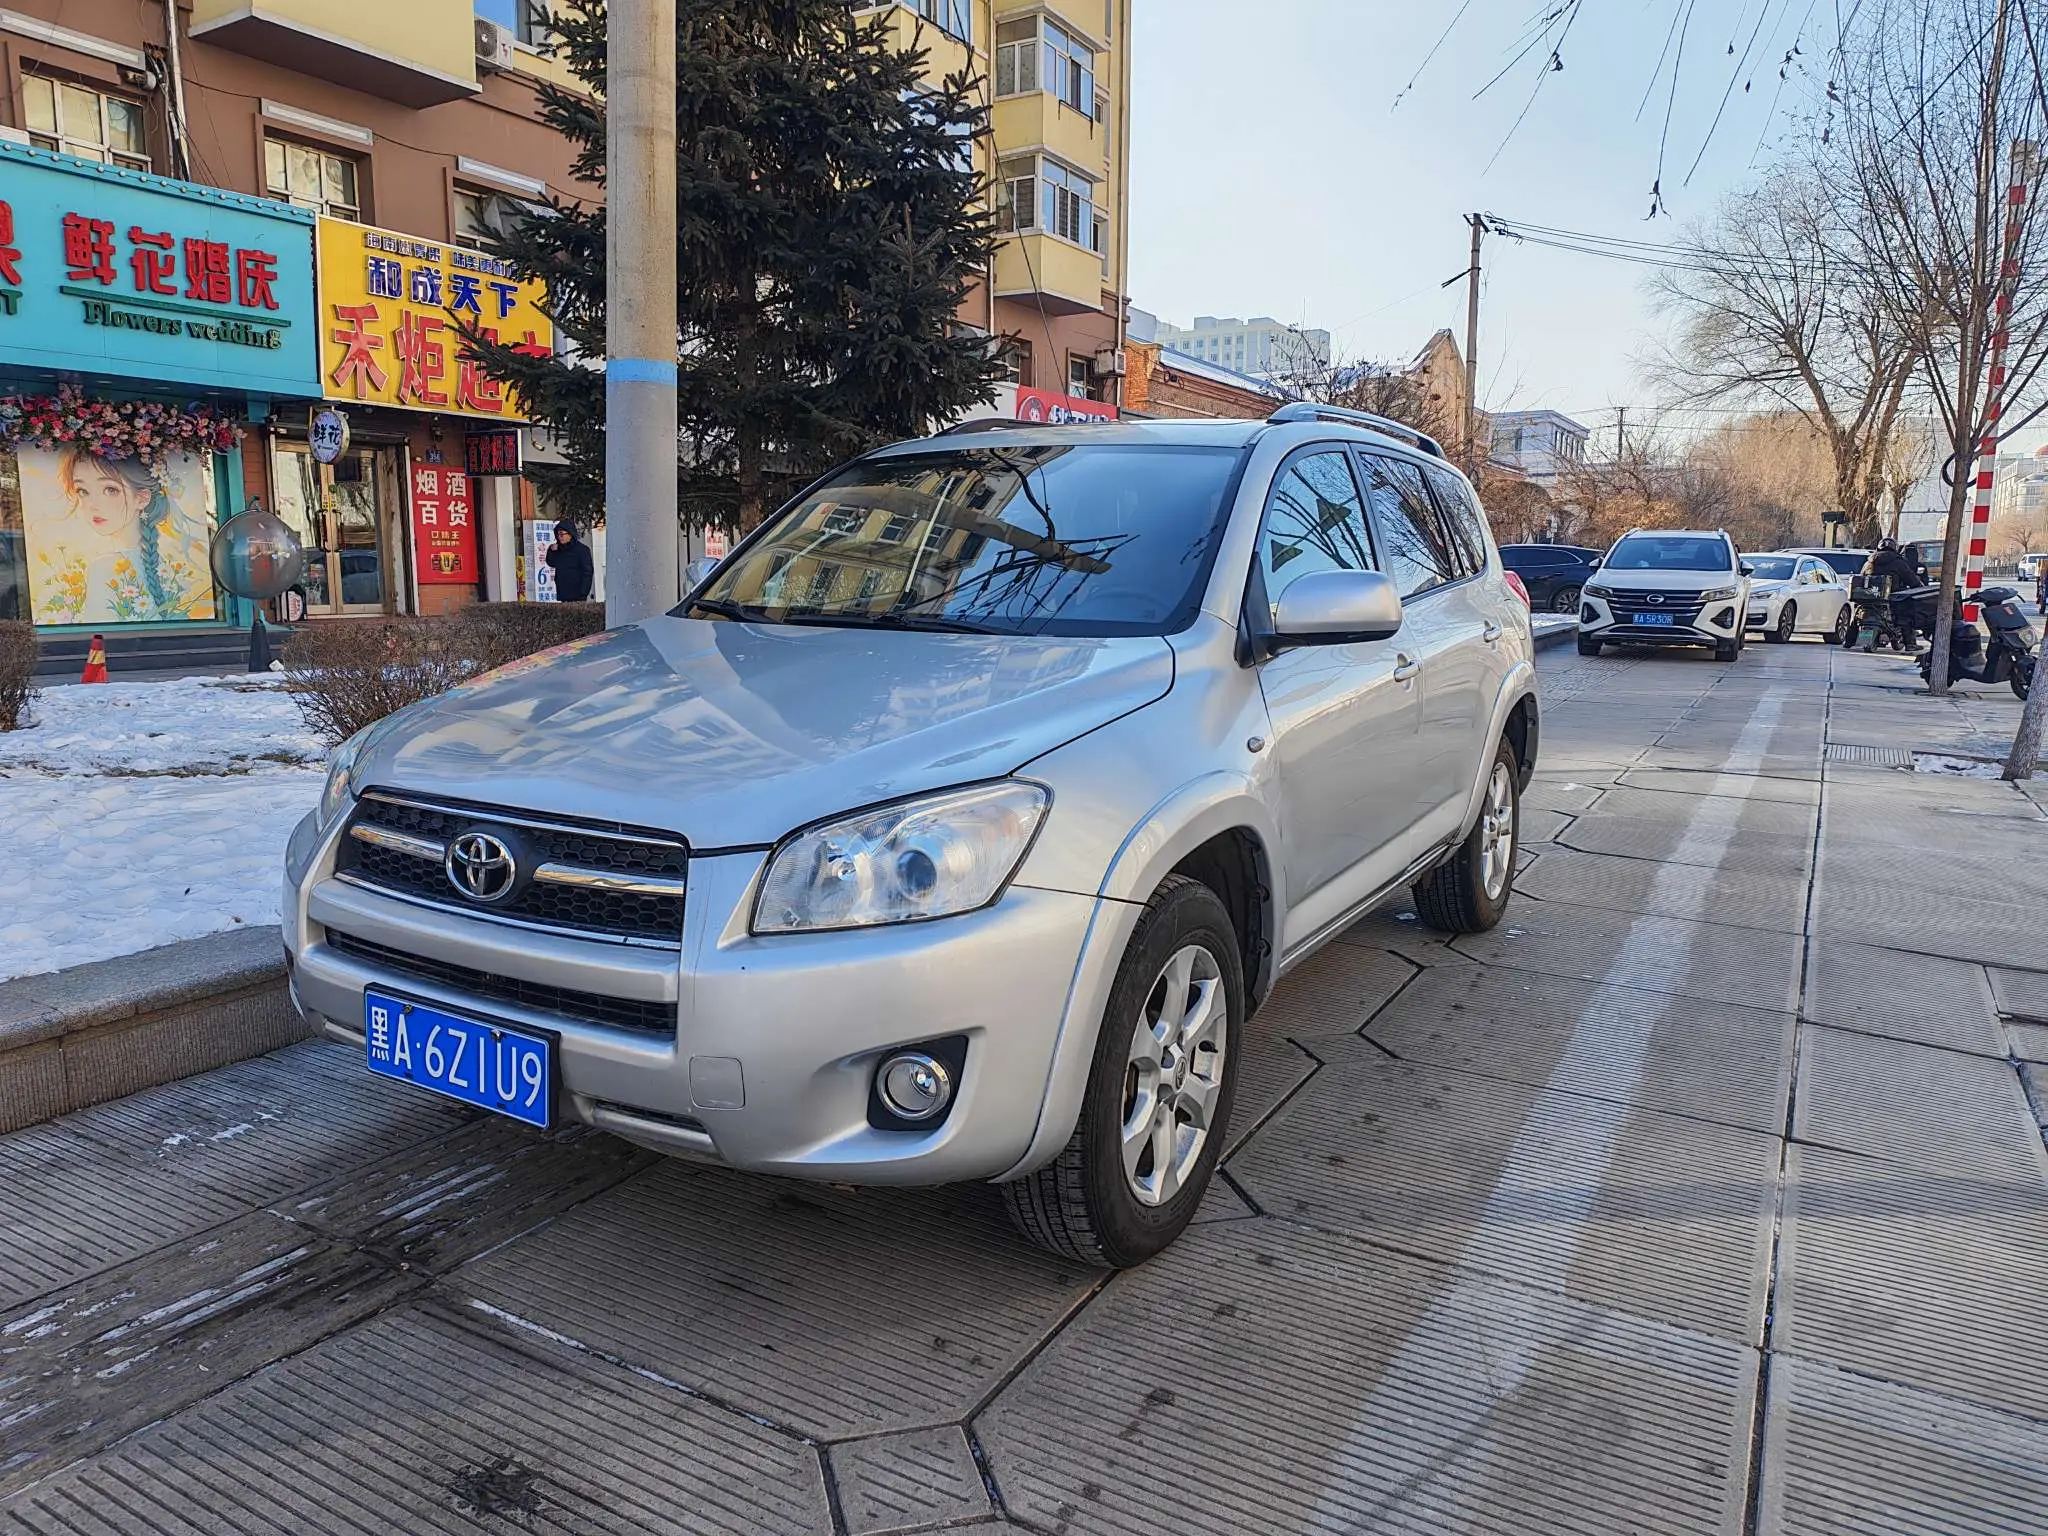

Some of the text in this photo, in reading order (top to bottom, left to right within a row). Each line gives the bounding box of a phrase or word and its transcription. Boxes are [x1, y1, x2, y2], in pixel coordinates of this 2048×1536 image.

[62, 212, 279, 310] 鲜花婚庆
[367, 255, 519, 318] 和成天下
[83, 300, 282, 349] Flowers wedding
[314, 423, 339, 445] 鲜花
[466, 435, 516, 473] 百货烟酒
[416, 469, 467, 497] 烟酒
[417, 500, 469, 527] 百货
[371, 1006, 542, 1108] 黑A·6Z1U9
